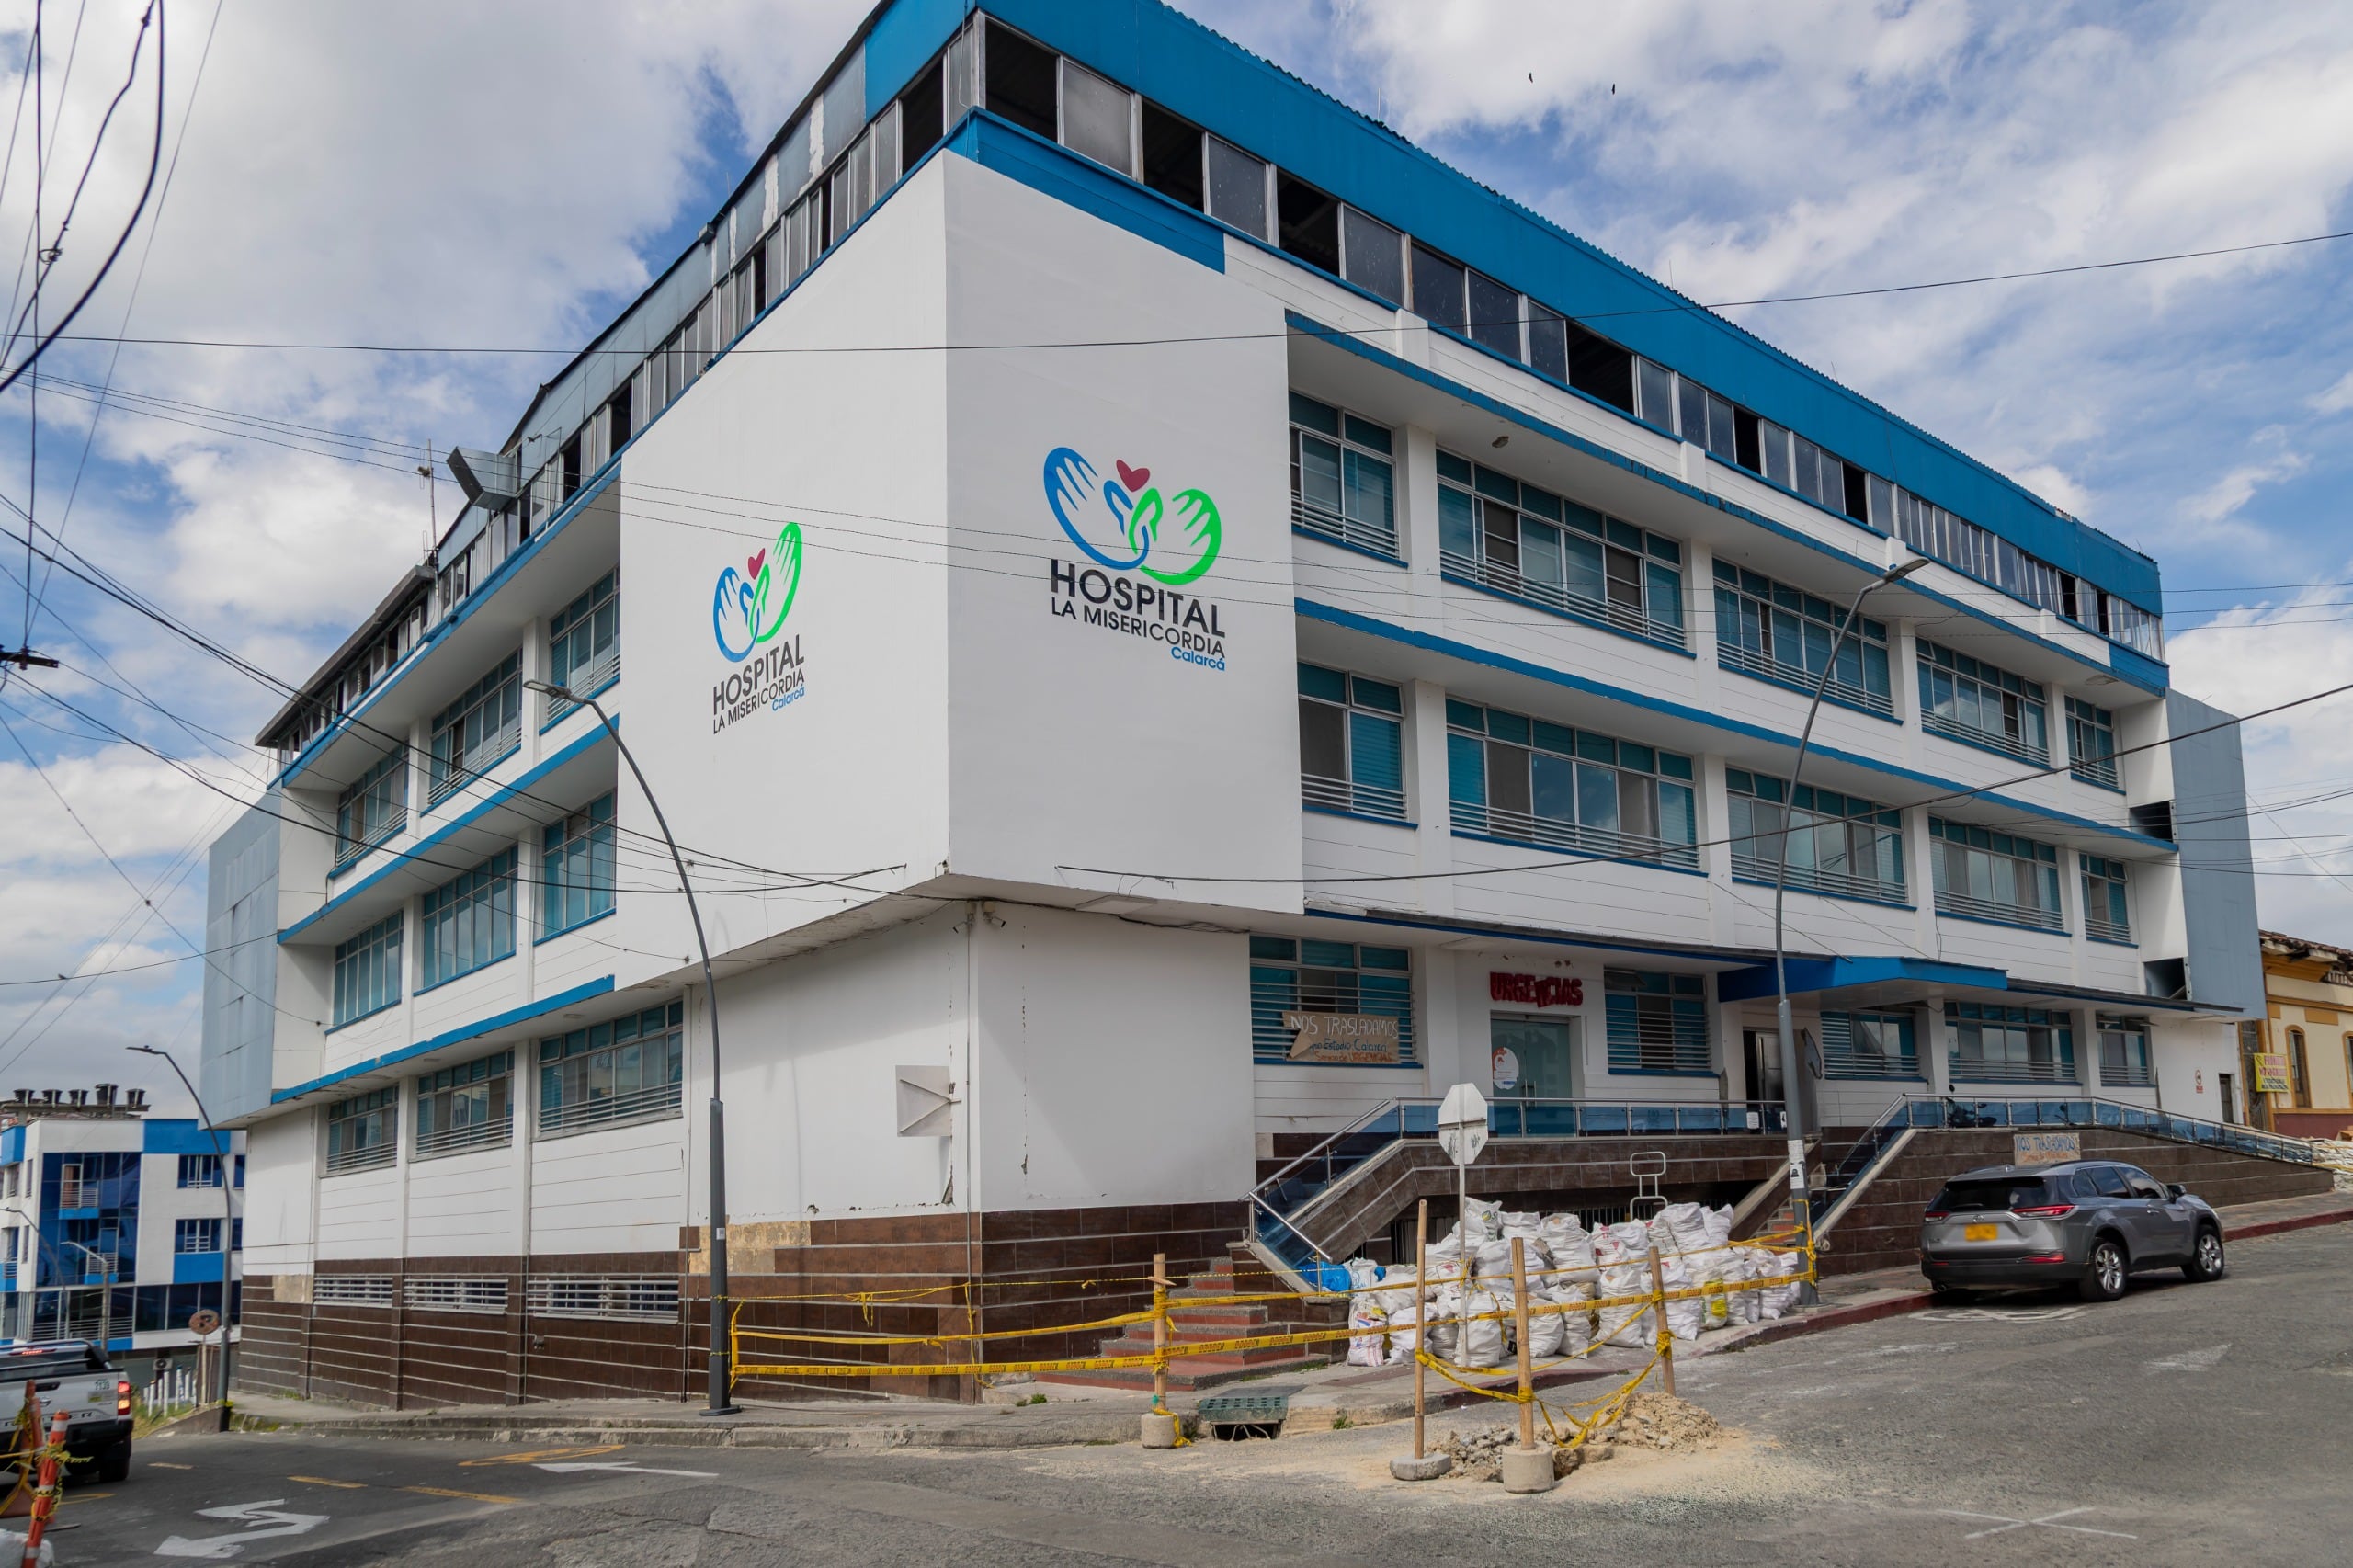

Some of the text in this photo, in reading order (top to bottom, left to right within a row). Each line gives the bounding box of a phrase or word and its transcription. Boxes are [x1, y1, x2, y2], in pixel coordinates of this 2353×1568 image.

[1051, 558, 1226, 638] HOSPITAL
[1051, 597, 1226, 658] LA MISERICORDIA
[713, 635, 804, 715] HOSPITAL
[1170, 646, 1225, 672] Calarcá
[712, 668, 804, 735] LA MISERICORDIA
[772, 684, 804, 710] Calarcá
[1290, 1015, 1398, 1040] NOS TRASLADAMOS
